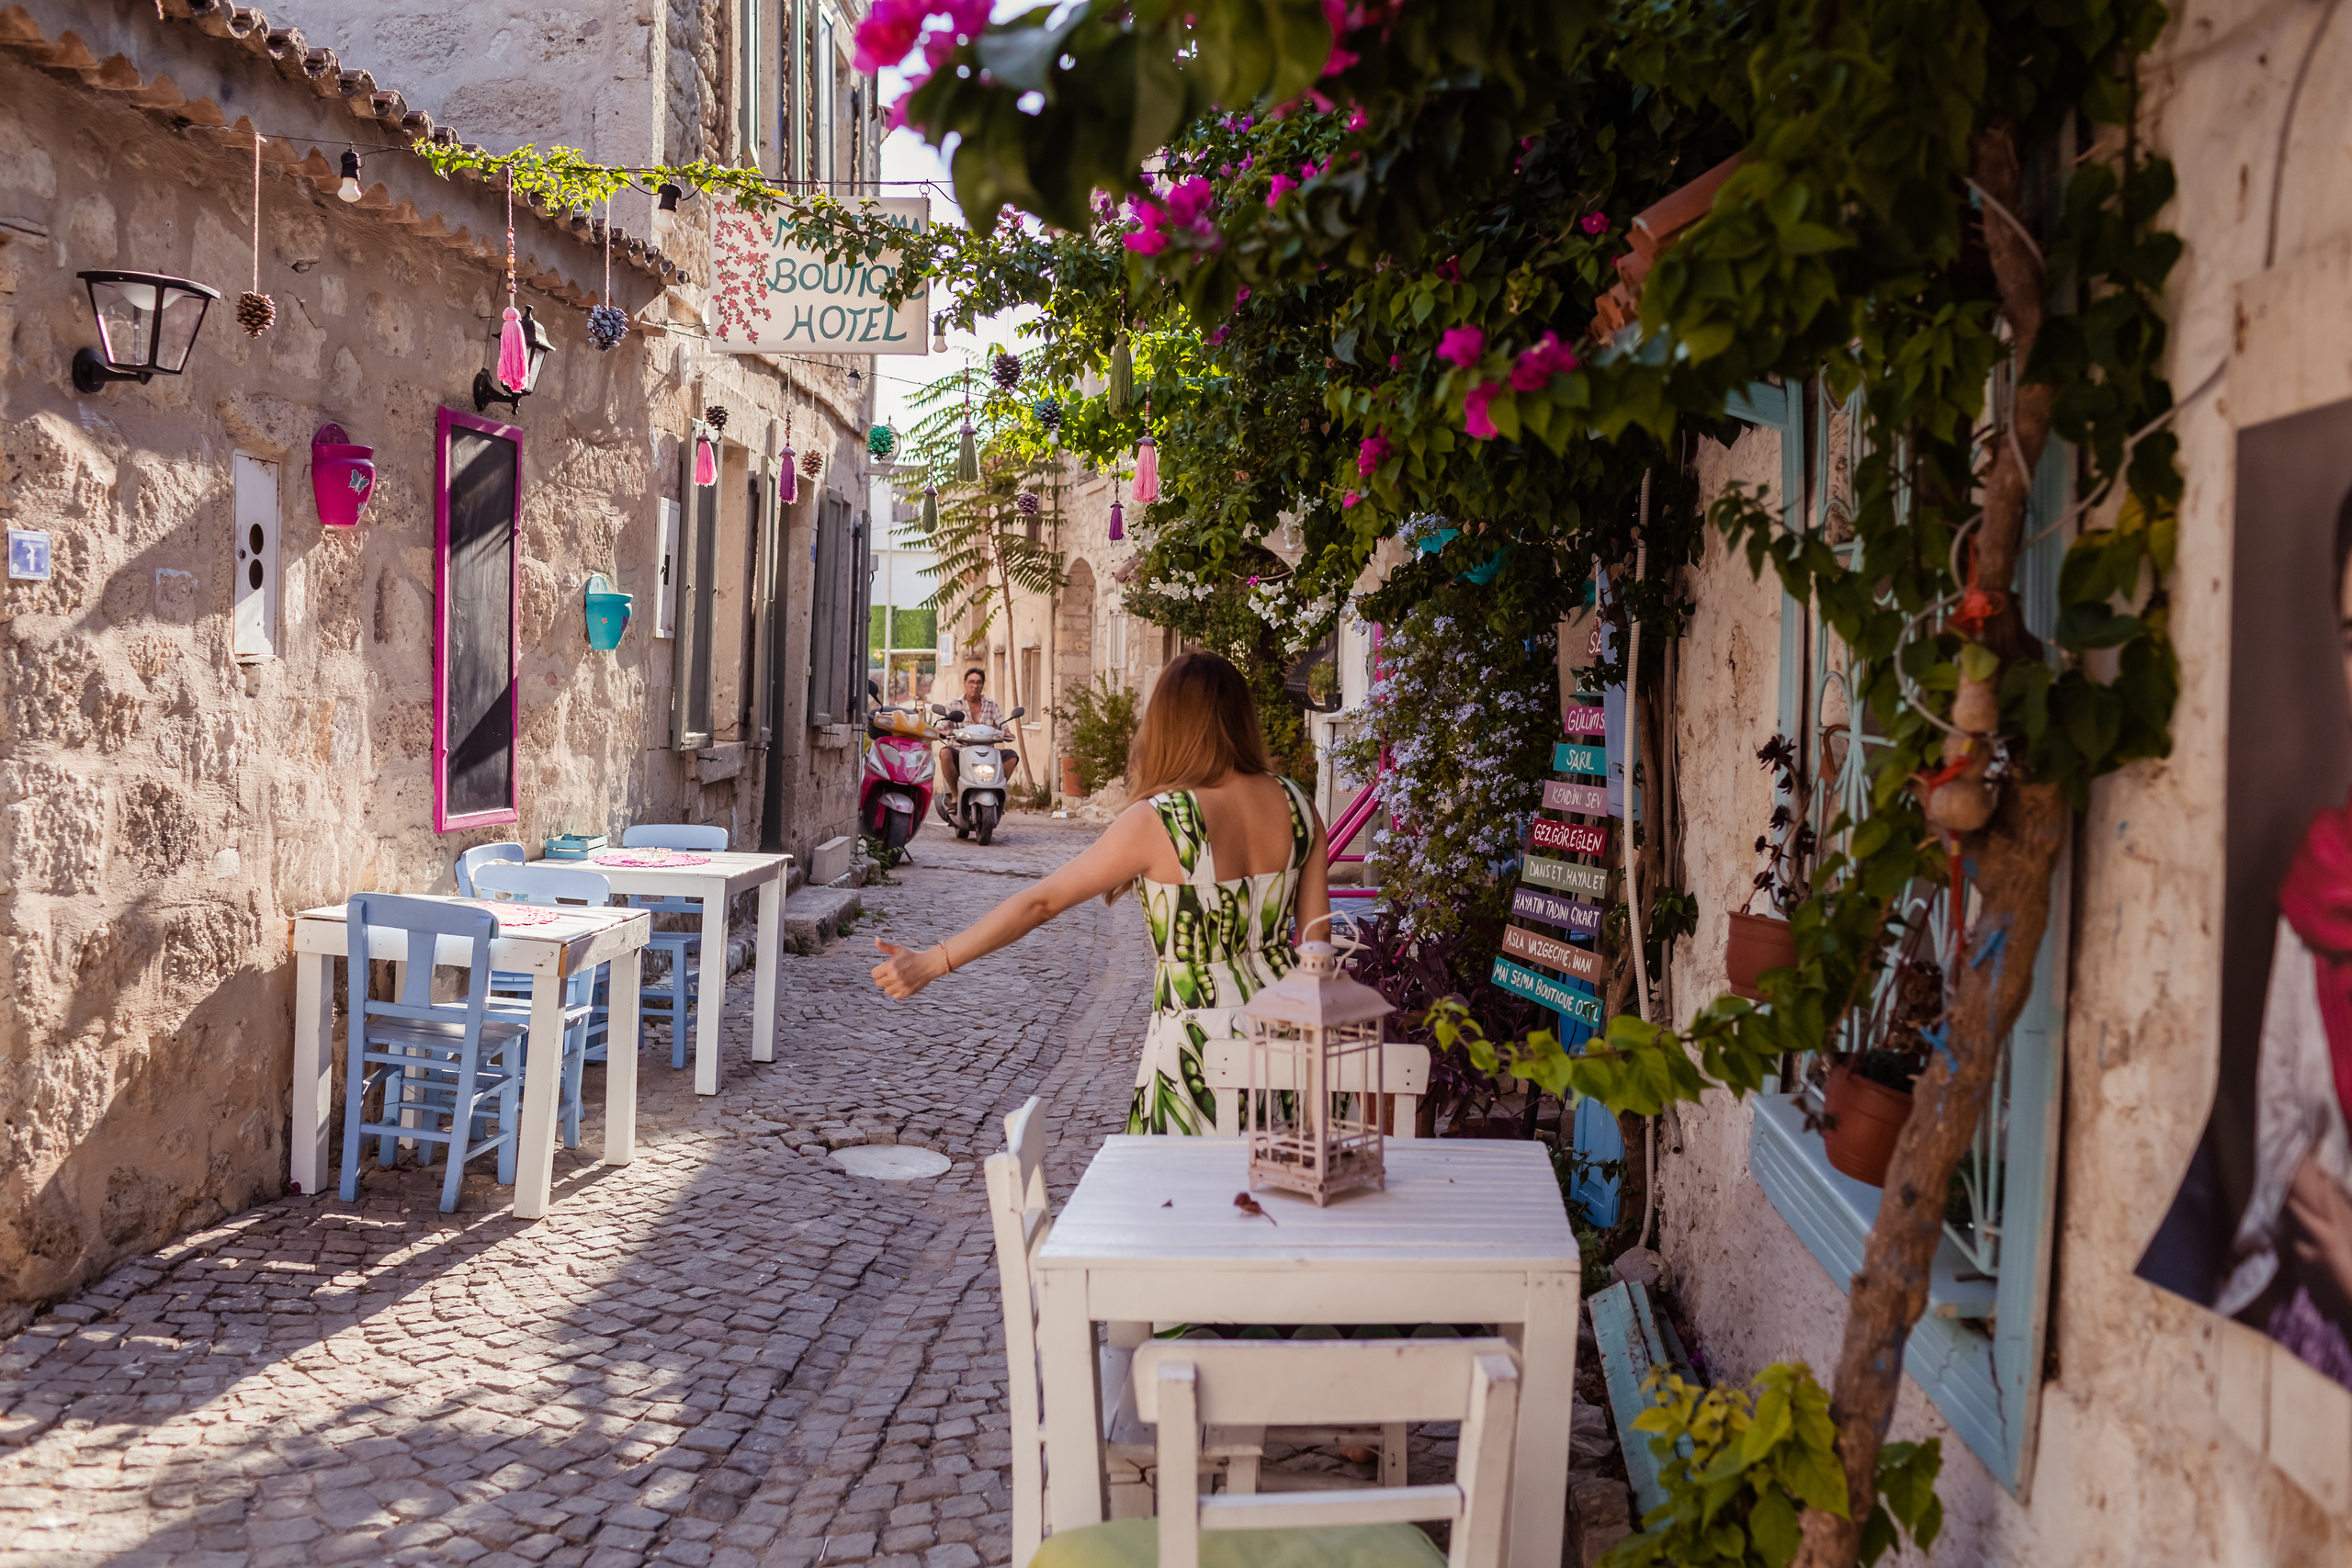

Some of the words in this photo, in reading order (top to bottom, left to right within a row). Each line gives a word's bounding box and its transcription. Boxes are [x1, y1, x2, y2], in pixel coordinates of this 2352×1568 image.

[765, 258, 925, 299] BOUTIQ
[784, 305, 907, 343] HOTEL
[1586, 793, 1603, 808] SEV
[1506, 931, 1524, 949] ASLA
[1511, 969, 1534, 990] SEMA
[1535, 978, 1574, 1011] BOUTIQUE
